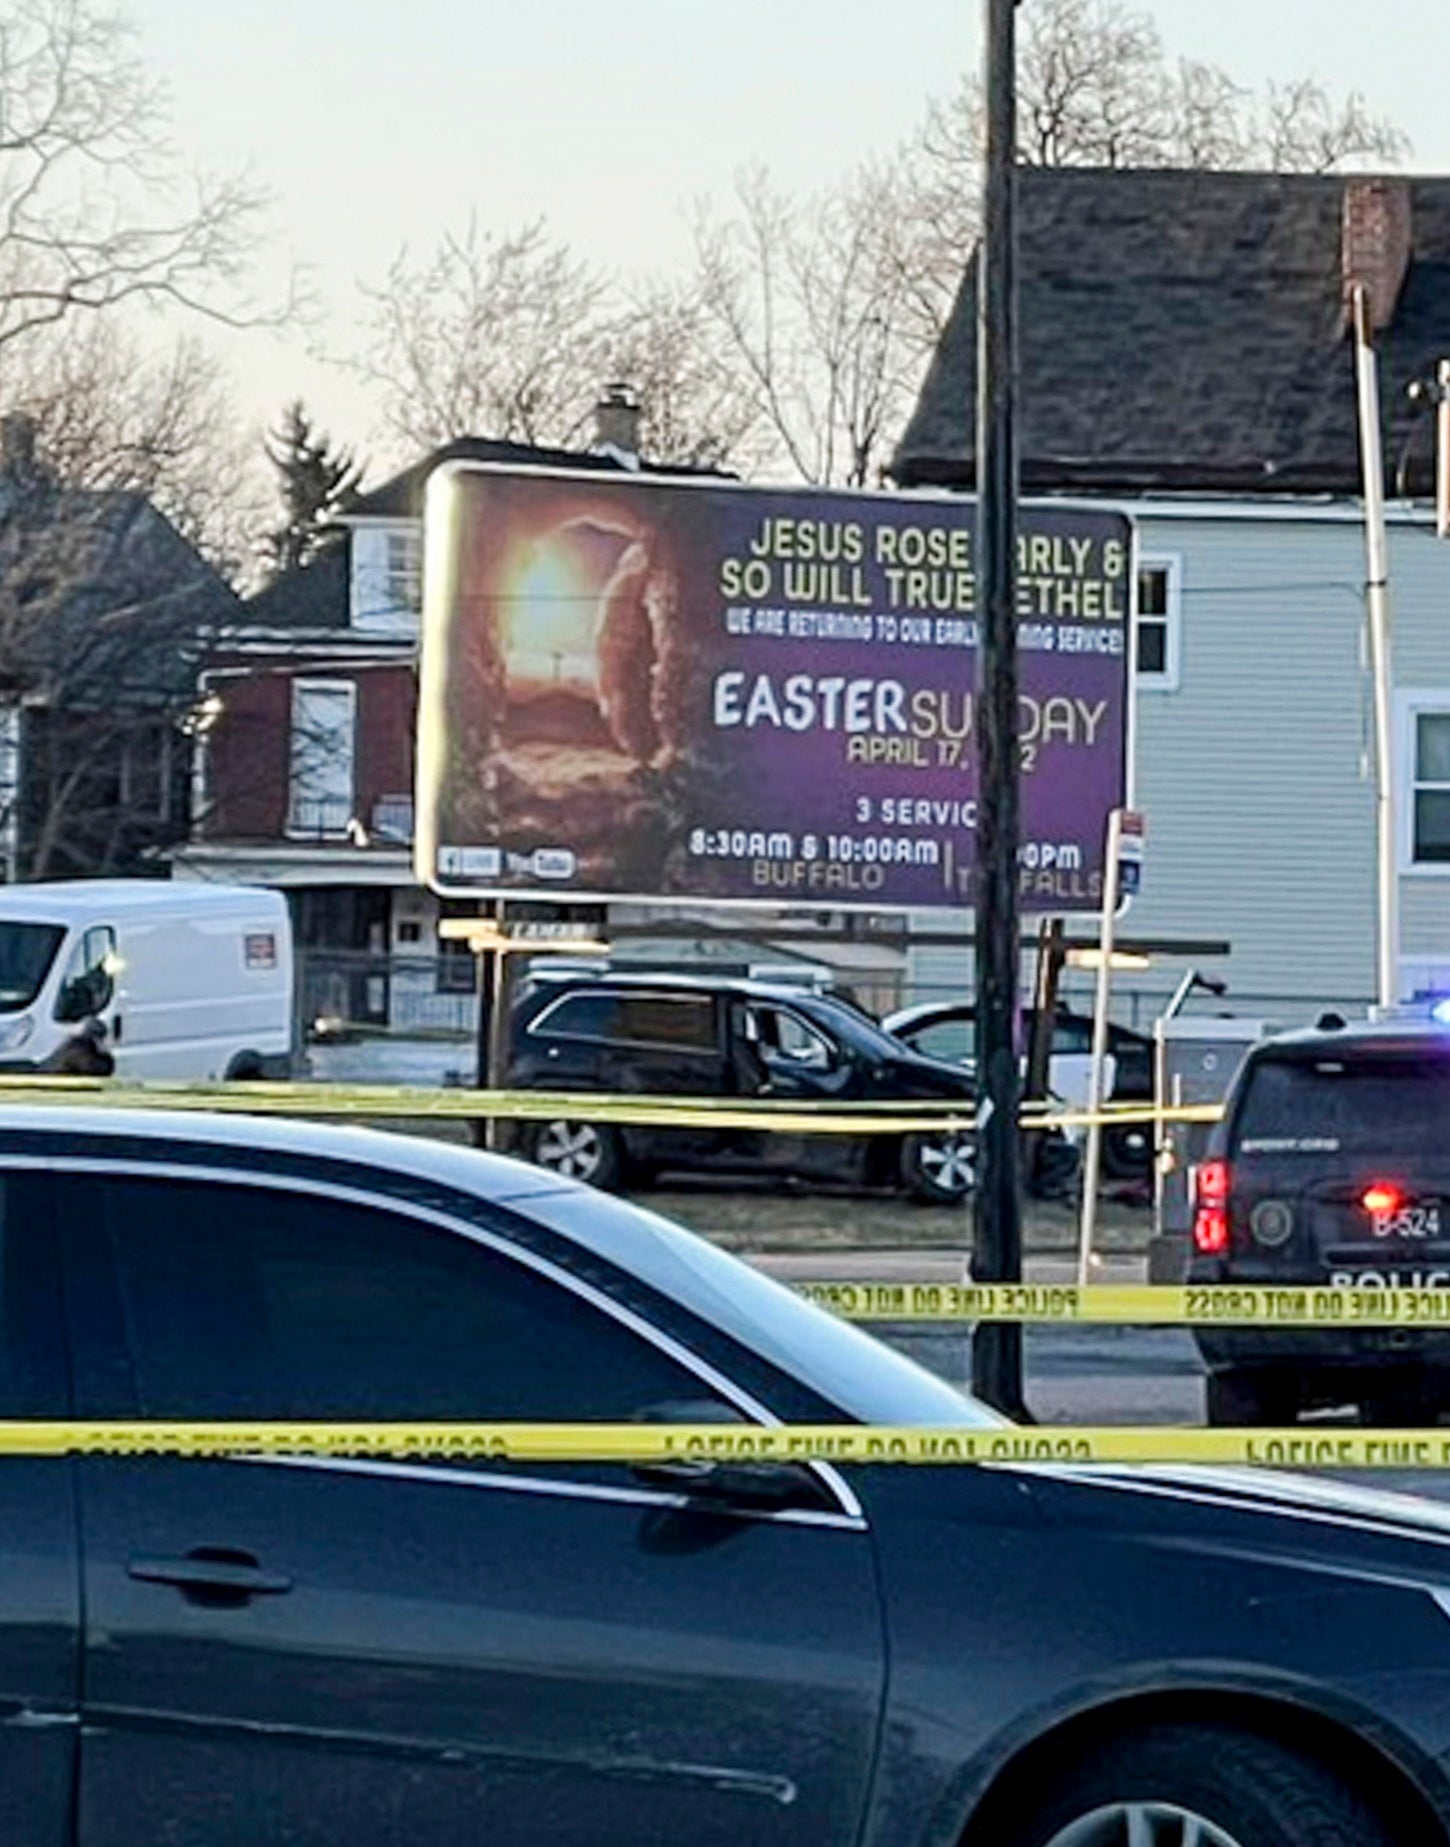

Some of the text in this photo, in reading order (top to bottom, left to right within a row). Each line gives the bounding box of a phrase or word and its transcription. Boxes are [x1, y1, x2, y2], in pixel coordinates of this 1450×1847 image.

[751, 518, 1124, 576] JESUS ROSE ARLY &
[720, 560, 1123, 620] SO WILL TRUE ETHEL
[726, 607, 752, 635] WE
[877, 616, 898, 642] TO
[714, 672, 1108, 745] EASTER SUDAY
[847, 735, 928, 767] APRIL
[856, 799, 871, 824] 3
[689, 828, 793, 860] 8:30AM
[803, 835, 817, 861] &
[828, 835, 940, 866] 10:00AM
[753, 861, 885, 890] BUFFALO
